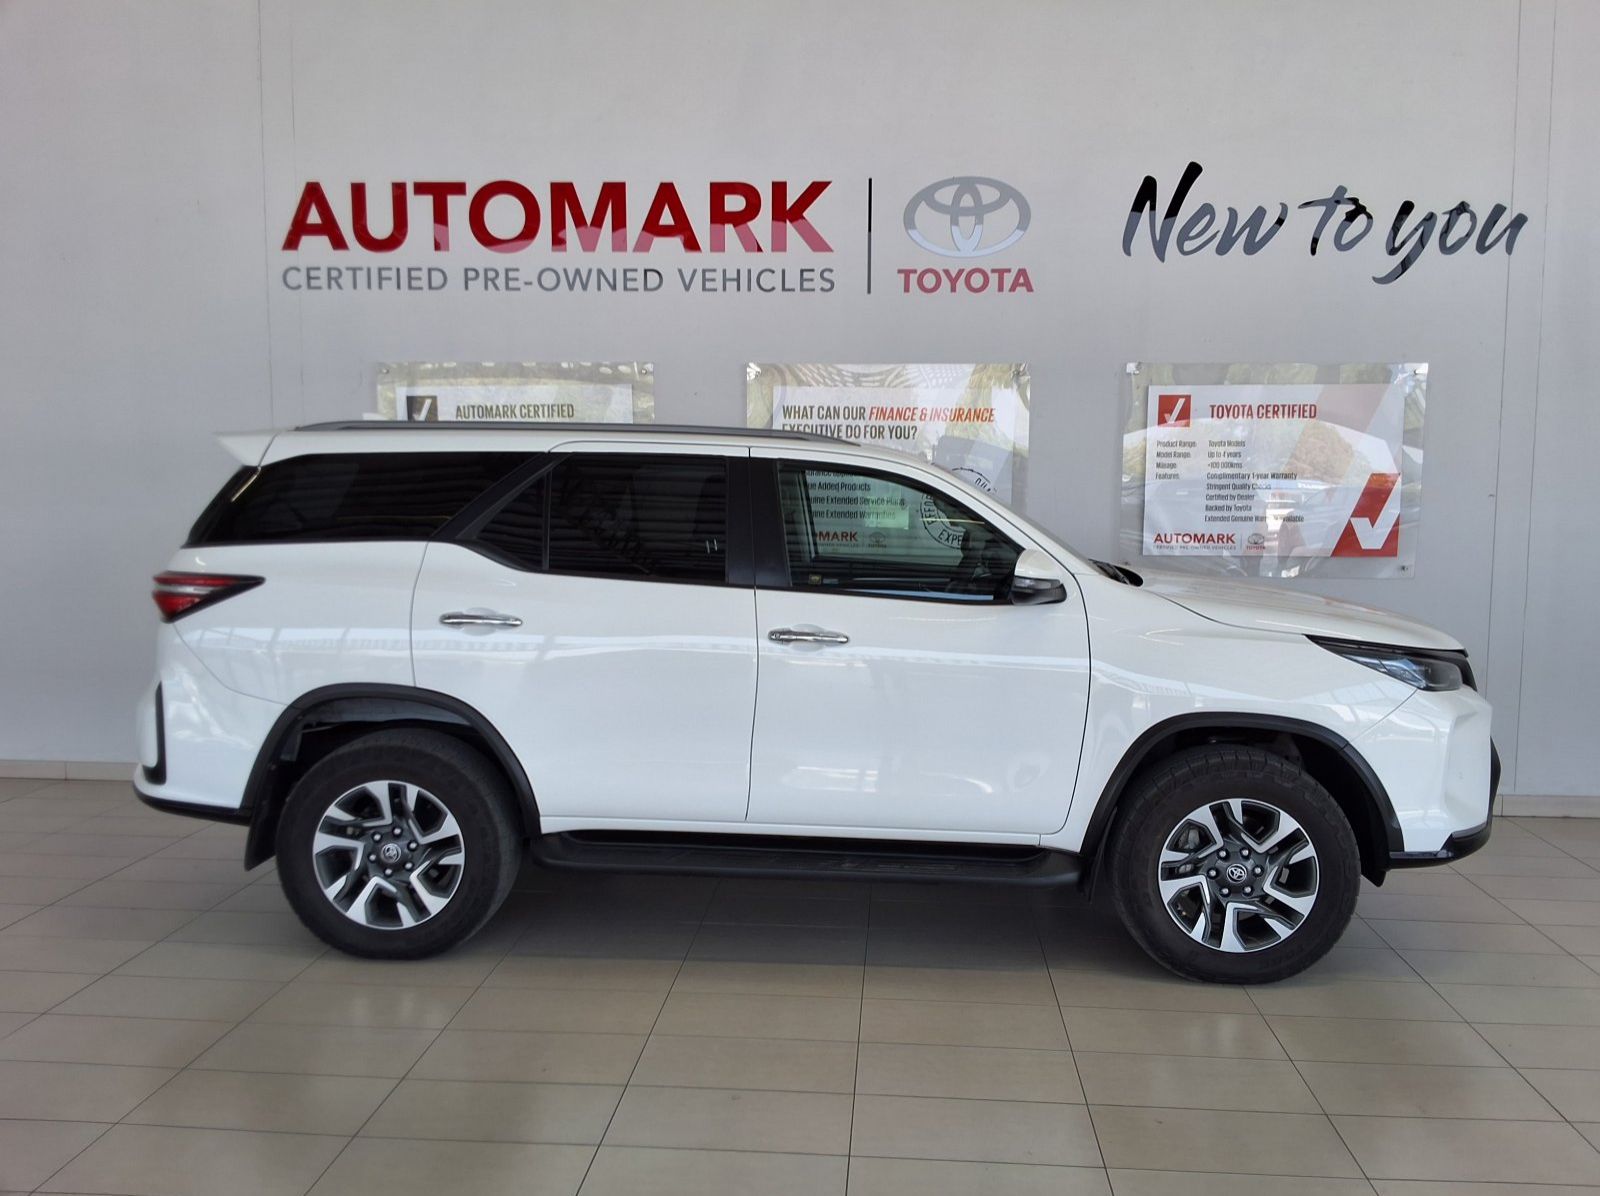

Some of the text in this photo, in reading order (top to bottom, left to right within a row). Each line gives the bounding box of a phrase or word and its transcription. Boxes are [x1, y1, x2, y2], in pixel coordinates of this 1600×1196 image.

[282, 180, 834, 253] AUTOMARK
[1122, 161, 1528, 286] New to you
[282, 266, 836, 293] CERTIFIED PRE-OWNED VEHICLES
[897, 268, 1034, 294] TOYOTA
[455, 403, 575, 420] AUTOMARK CERTIFIED
[782, 405, 815, 420] WHAT
[817, 406, 841, 420] CAN
[843, 406, 866, 420] OUR
[868, 406, 918, 421] FINANCE
[930, 407, 995, 422] INSURANCE
[1209, 404, 1317, 419] TOYOTA CERTIFIED
[846, 424, 861, 439] DO
[864, 425, 885, 439] FOR
[888, 425, 918, 440] YOU?
[818, 482, 839, 491] Added
[840, 482, 871, 491] Products
[826, 496, 858, 505] Extended
[826, 510, 857, 519] Extended
[816, 531, 858, 542] MARK
[1154, 533, 1236, 544] AUTOMARK
